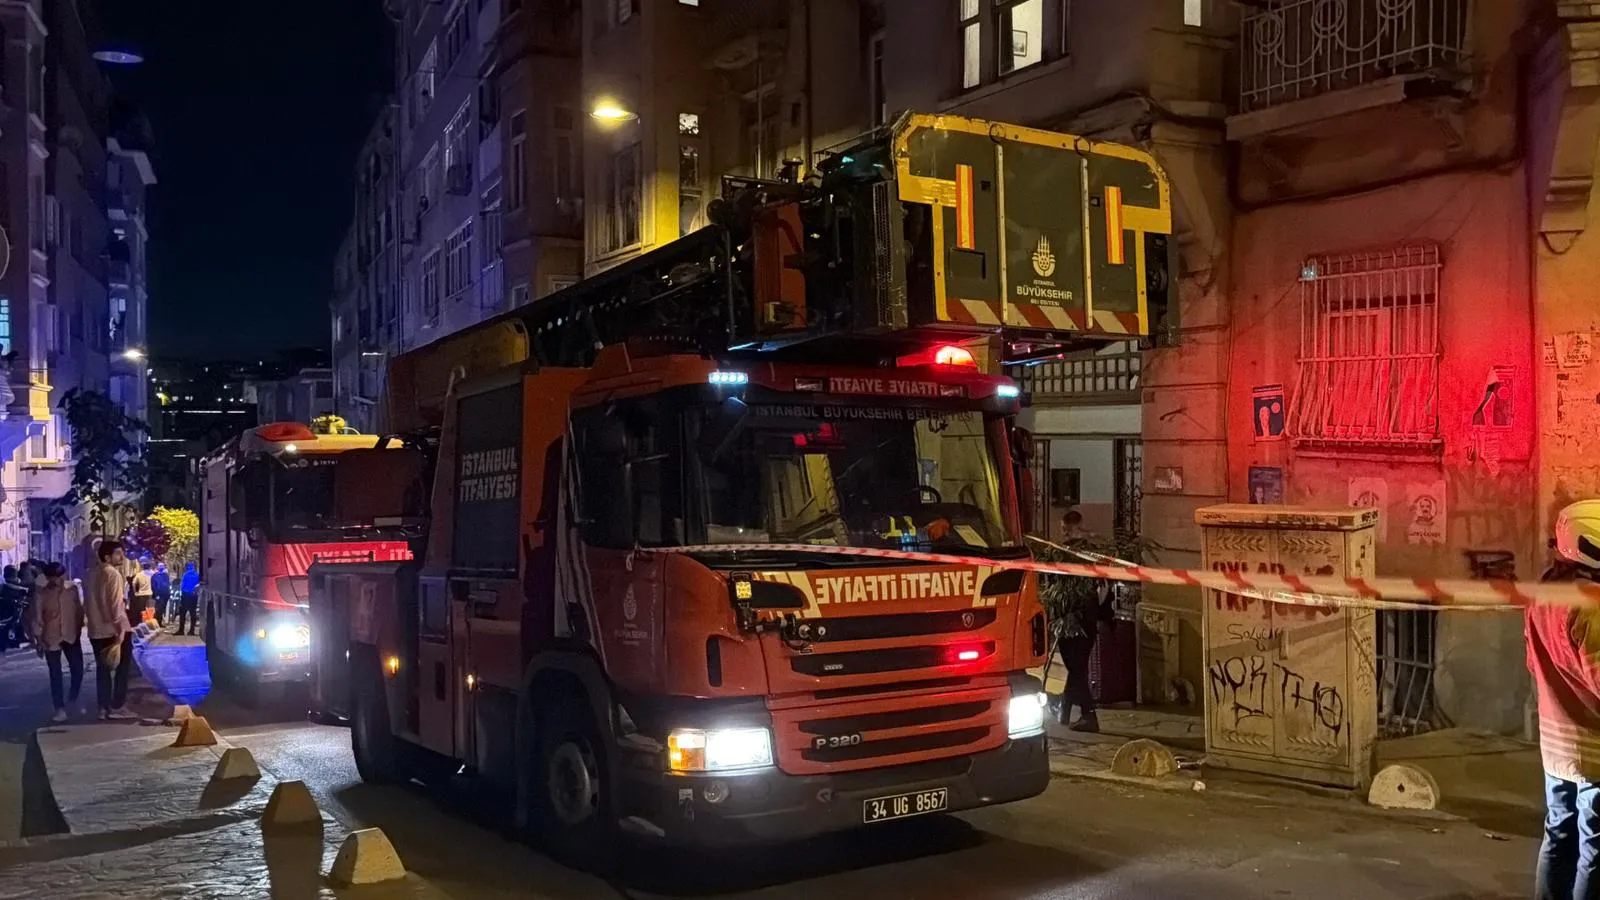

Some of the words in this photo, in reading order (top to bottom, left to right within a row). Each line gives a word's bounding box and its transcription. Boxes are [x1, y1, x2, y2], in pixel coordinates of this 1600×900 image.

[830, 377, 884, 393] İTFAİYE
[900, 570, 975, 600] İTFAİYE
[816, 739, 826, 750] P
[829, 734, 861, 748] 320
[871, 801, 887, 820] 34
[893, 796, 909, 815] UG
[916, 790, 946, 811] 8567
